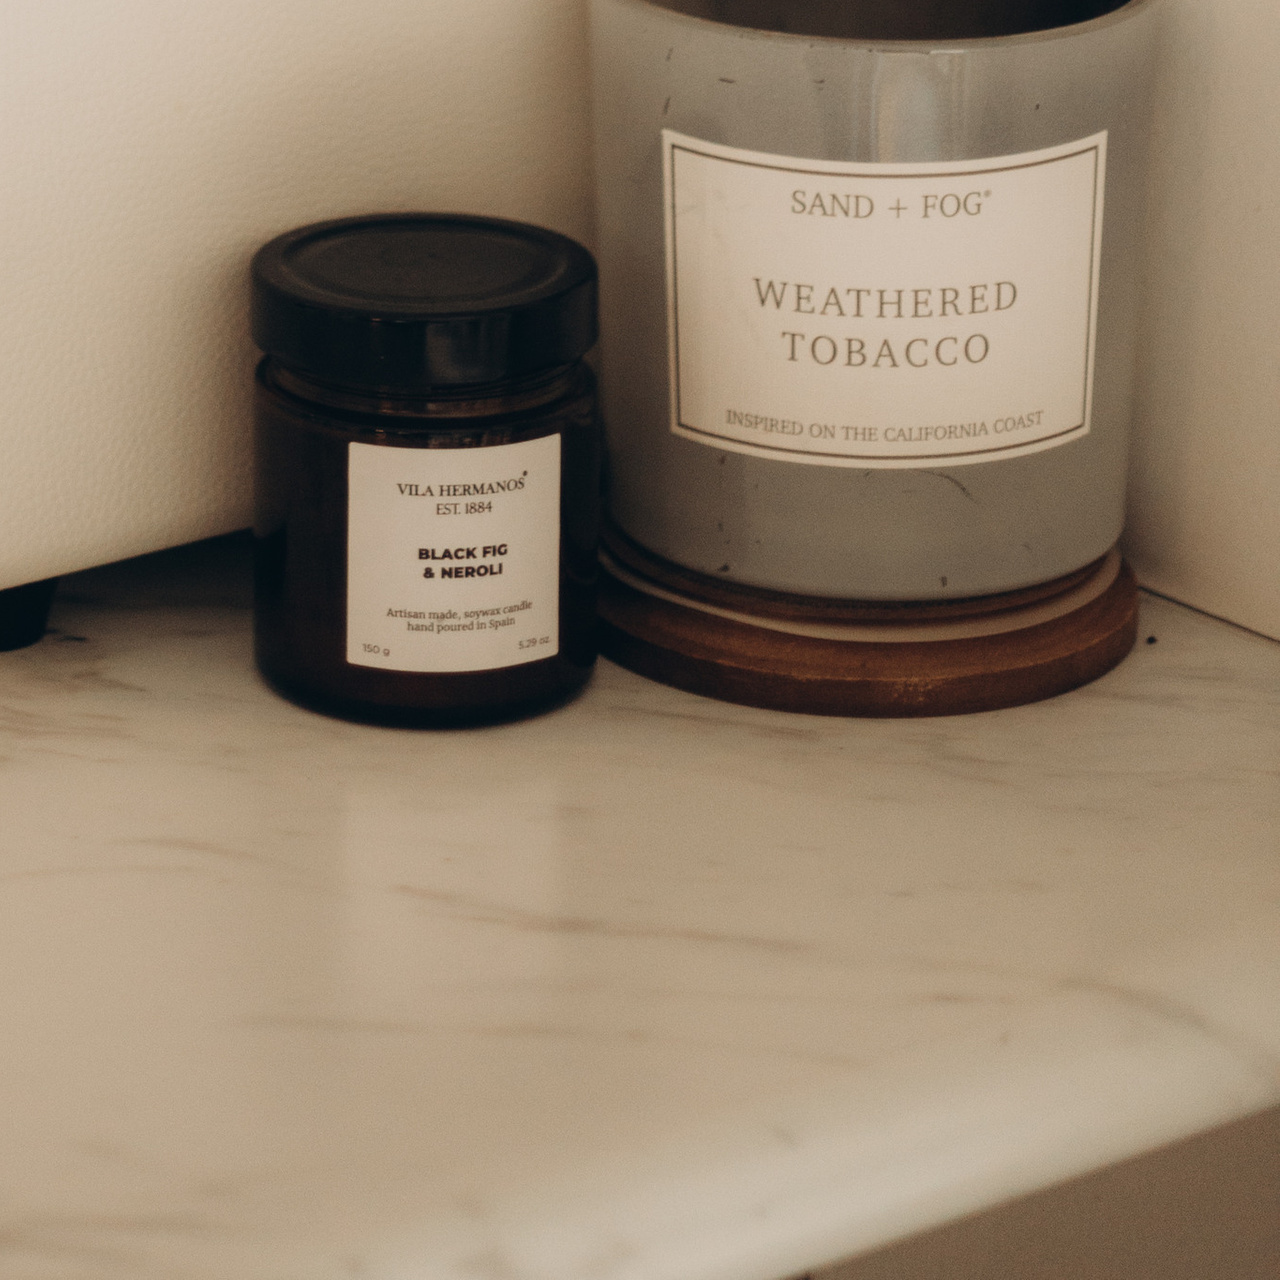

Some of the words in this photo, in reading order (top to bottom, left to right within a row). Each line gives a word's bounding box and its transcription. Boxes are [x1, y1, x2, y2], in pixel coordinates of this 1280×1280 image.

[790, 190, 874, 220] SAND
[753, 277, 1017, 319] WEATHERED
[782, 332, 990, 368] TOBACCO
[725, 409, 804, 437] INSPIRED
[809, 423, 836, 440] ON
[841, 426, 879, 441] THE
[884, 420, 989, 442] CALIFORNIA
[993, 410, 1045, 435] COAST
[397, 483, 434, 497] VILA
[465, 501, 492, 514] 1884
[418, 547, 477, 560] BLACK
[482, 543, 508, 558] FIG
[423, 567, 434, 579] &
[441, 563, 503, 579] NEROLI
[386, 607, 426, 619] Artisan
[464, 607, 501, 620] soywax
[503, 600, 533, 614] candle
[407, 621, 434, 632] hand
[437, 621, 474, 634] poured
[477, 620, 487, 630] in
[489, 617, 516, 630] Spain
